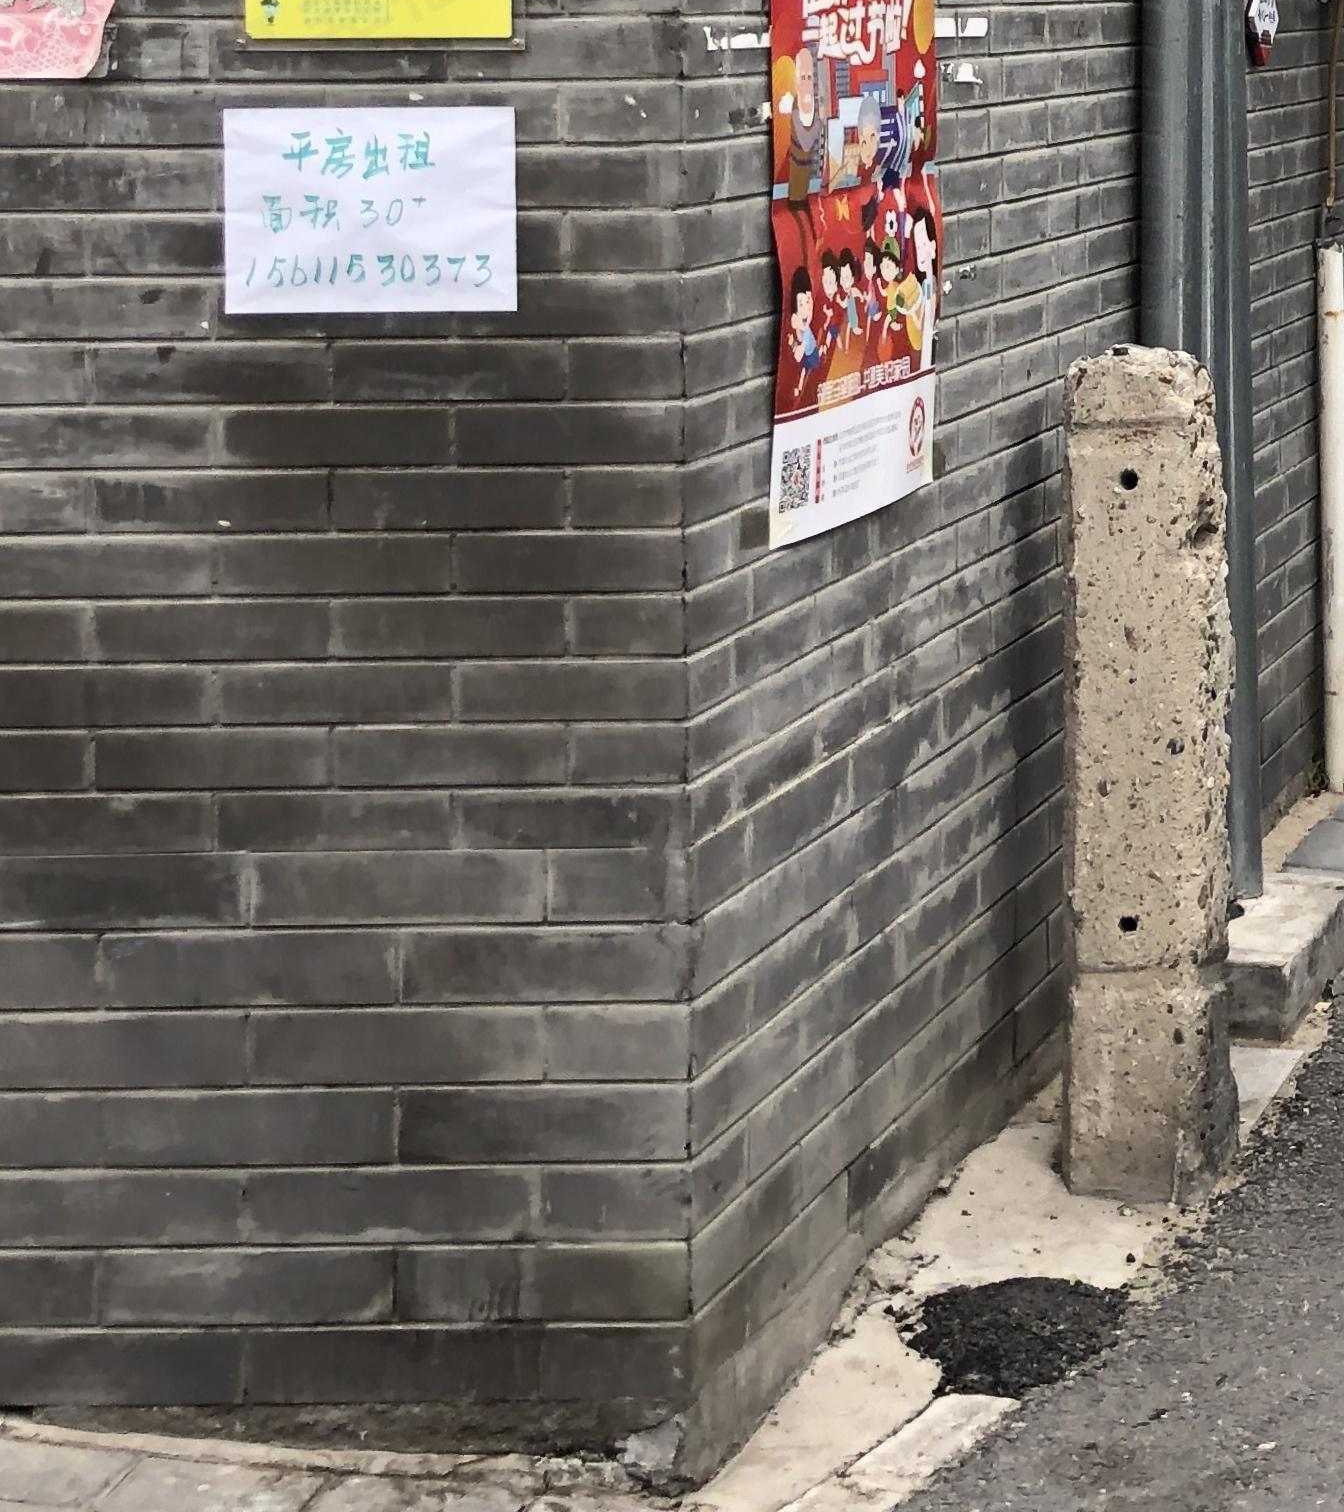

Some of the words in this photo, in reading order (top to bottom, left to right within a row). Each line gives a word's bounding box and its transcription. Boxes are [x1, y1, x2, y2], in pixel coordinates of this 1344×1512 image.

[282, 128, 436, 180] 平房出租
[260, 194, 341, 234] 面积
[246, 254, 494, 288] 15611530373
